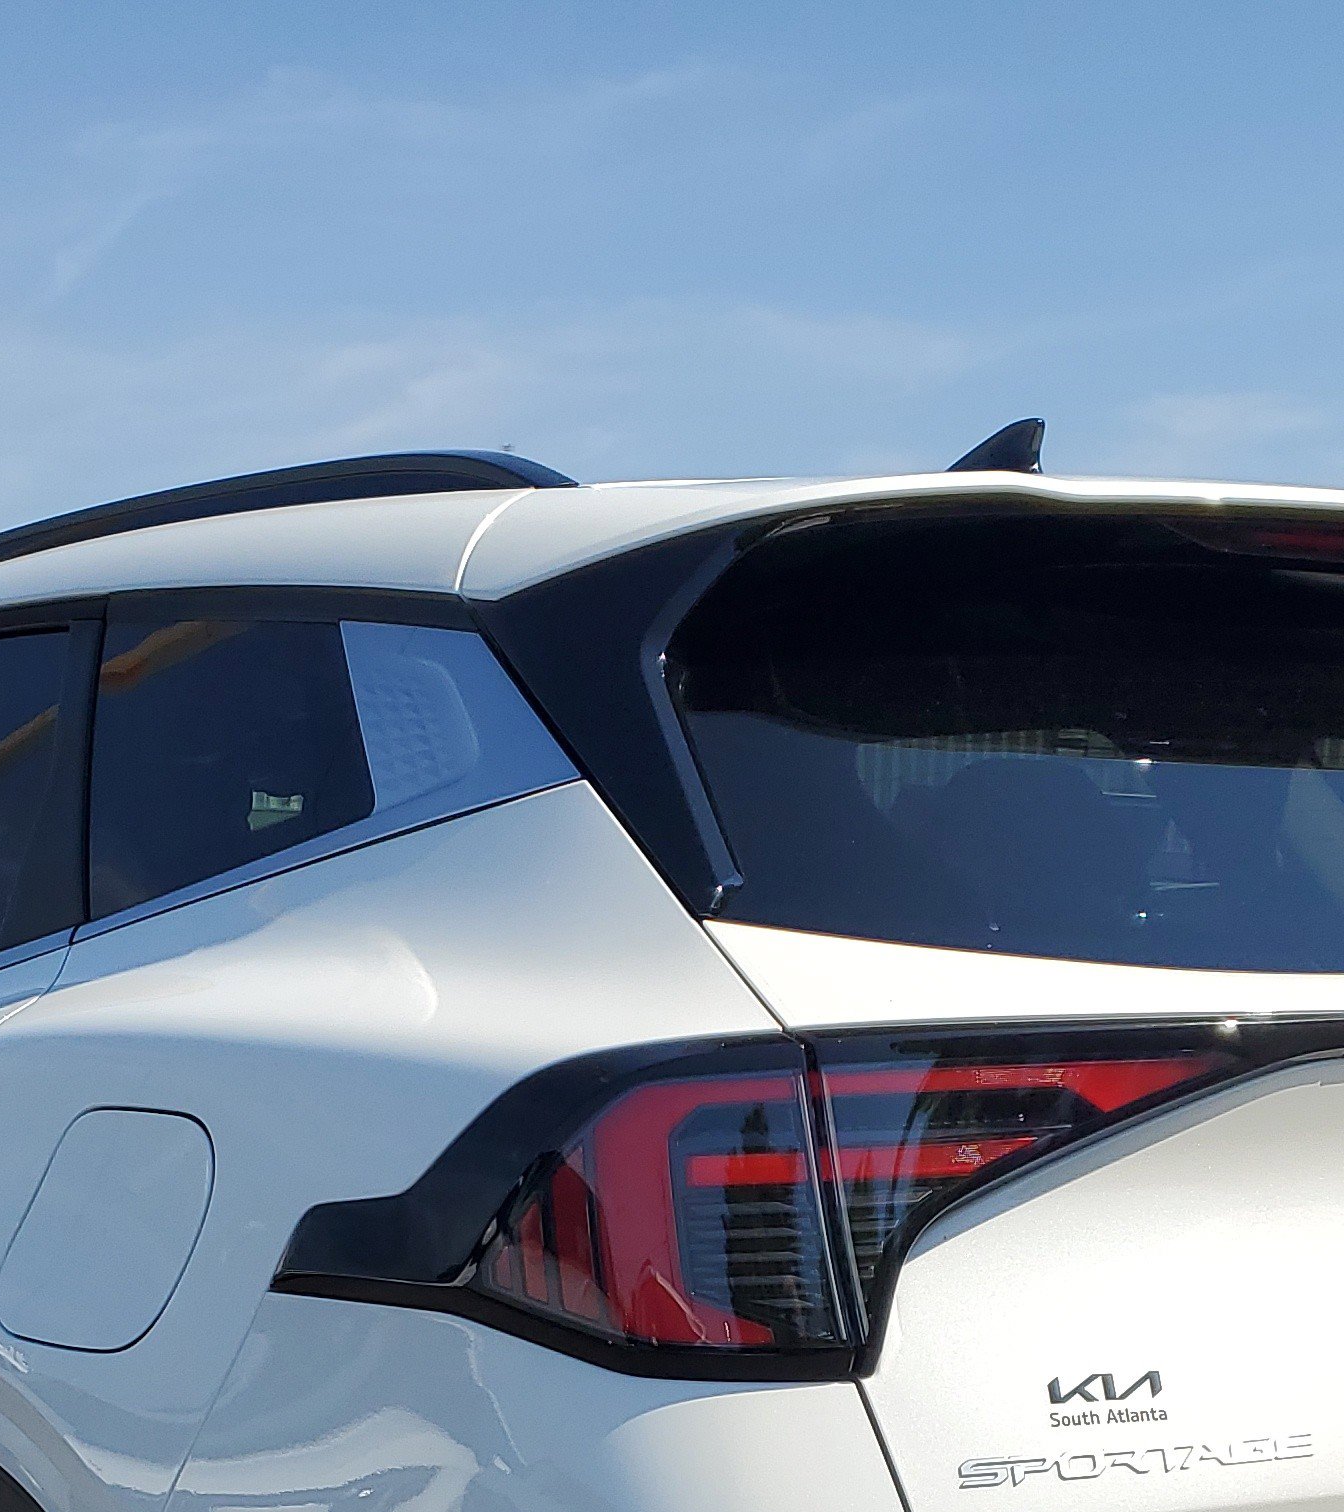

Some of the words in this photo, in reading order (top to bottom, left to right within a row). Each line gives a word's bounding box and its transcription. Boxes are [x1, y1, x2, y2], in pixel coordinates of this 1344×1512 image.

[1047, 1371, 1162, 1404] KIA
[1049, 1409, 1101, 1428] South
[1106, 1407, 1168, 1424] Atlanta
[958, 1434, 1315, 1490] SPORTAGE
